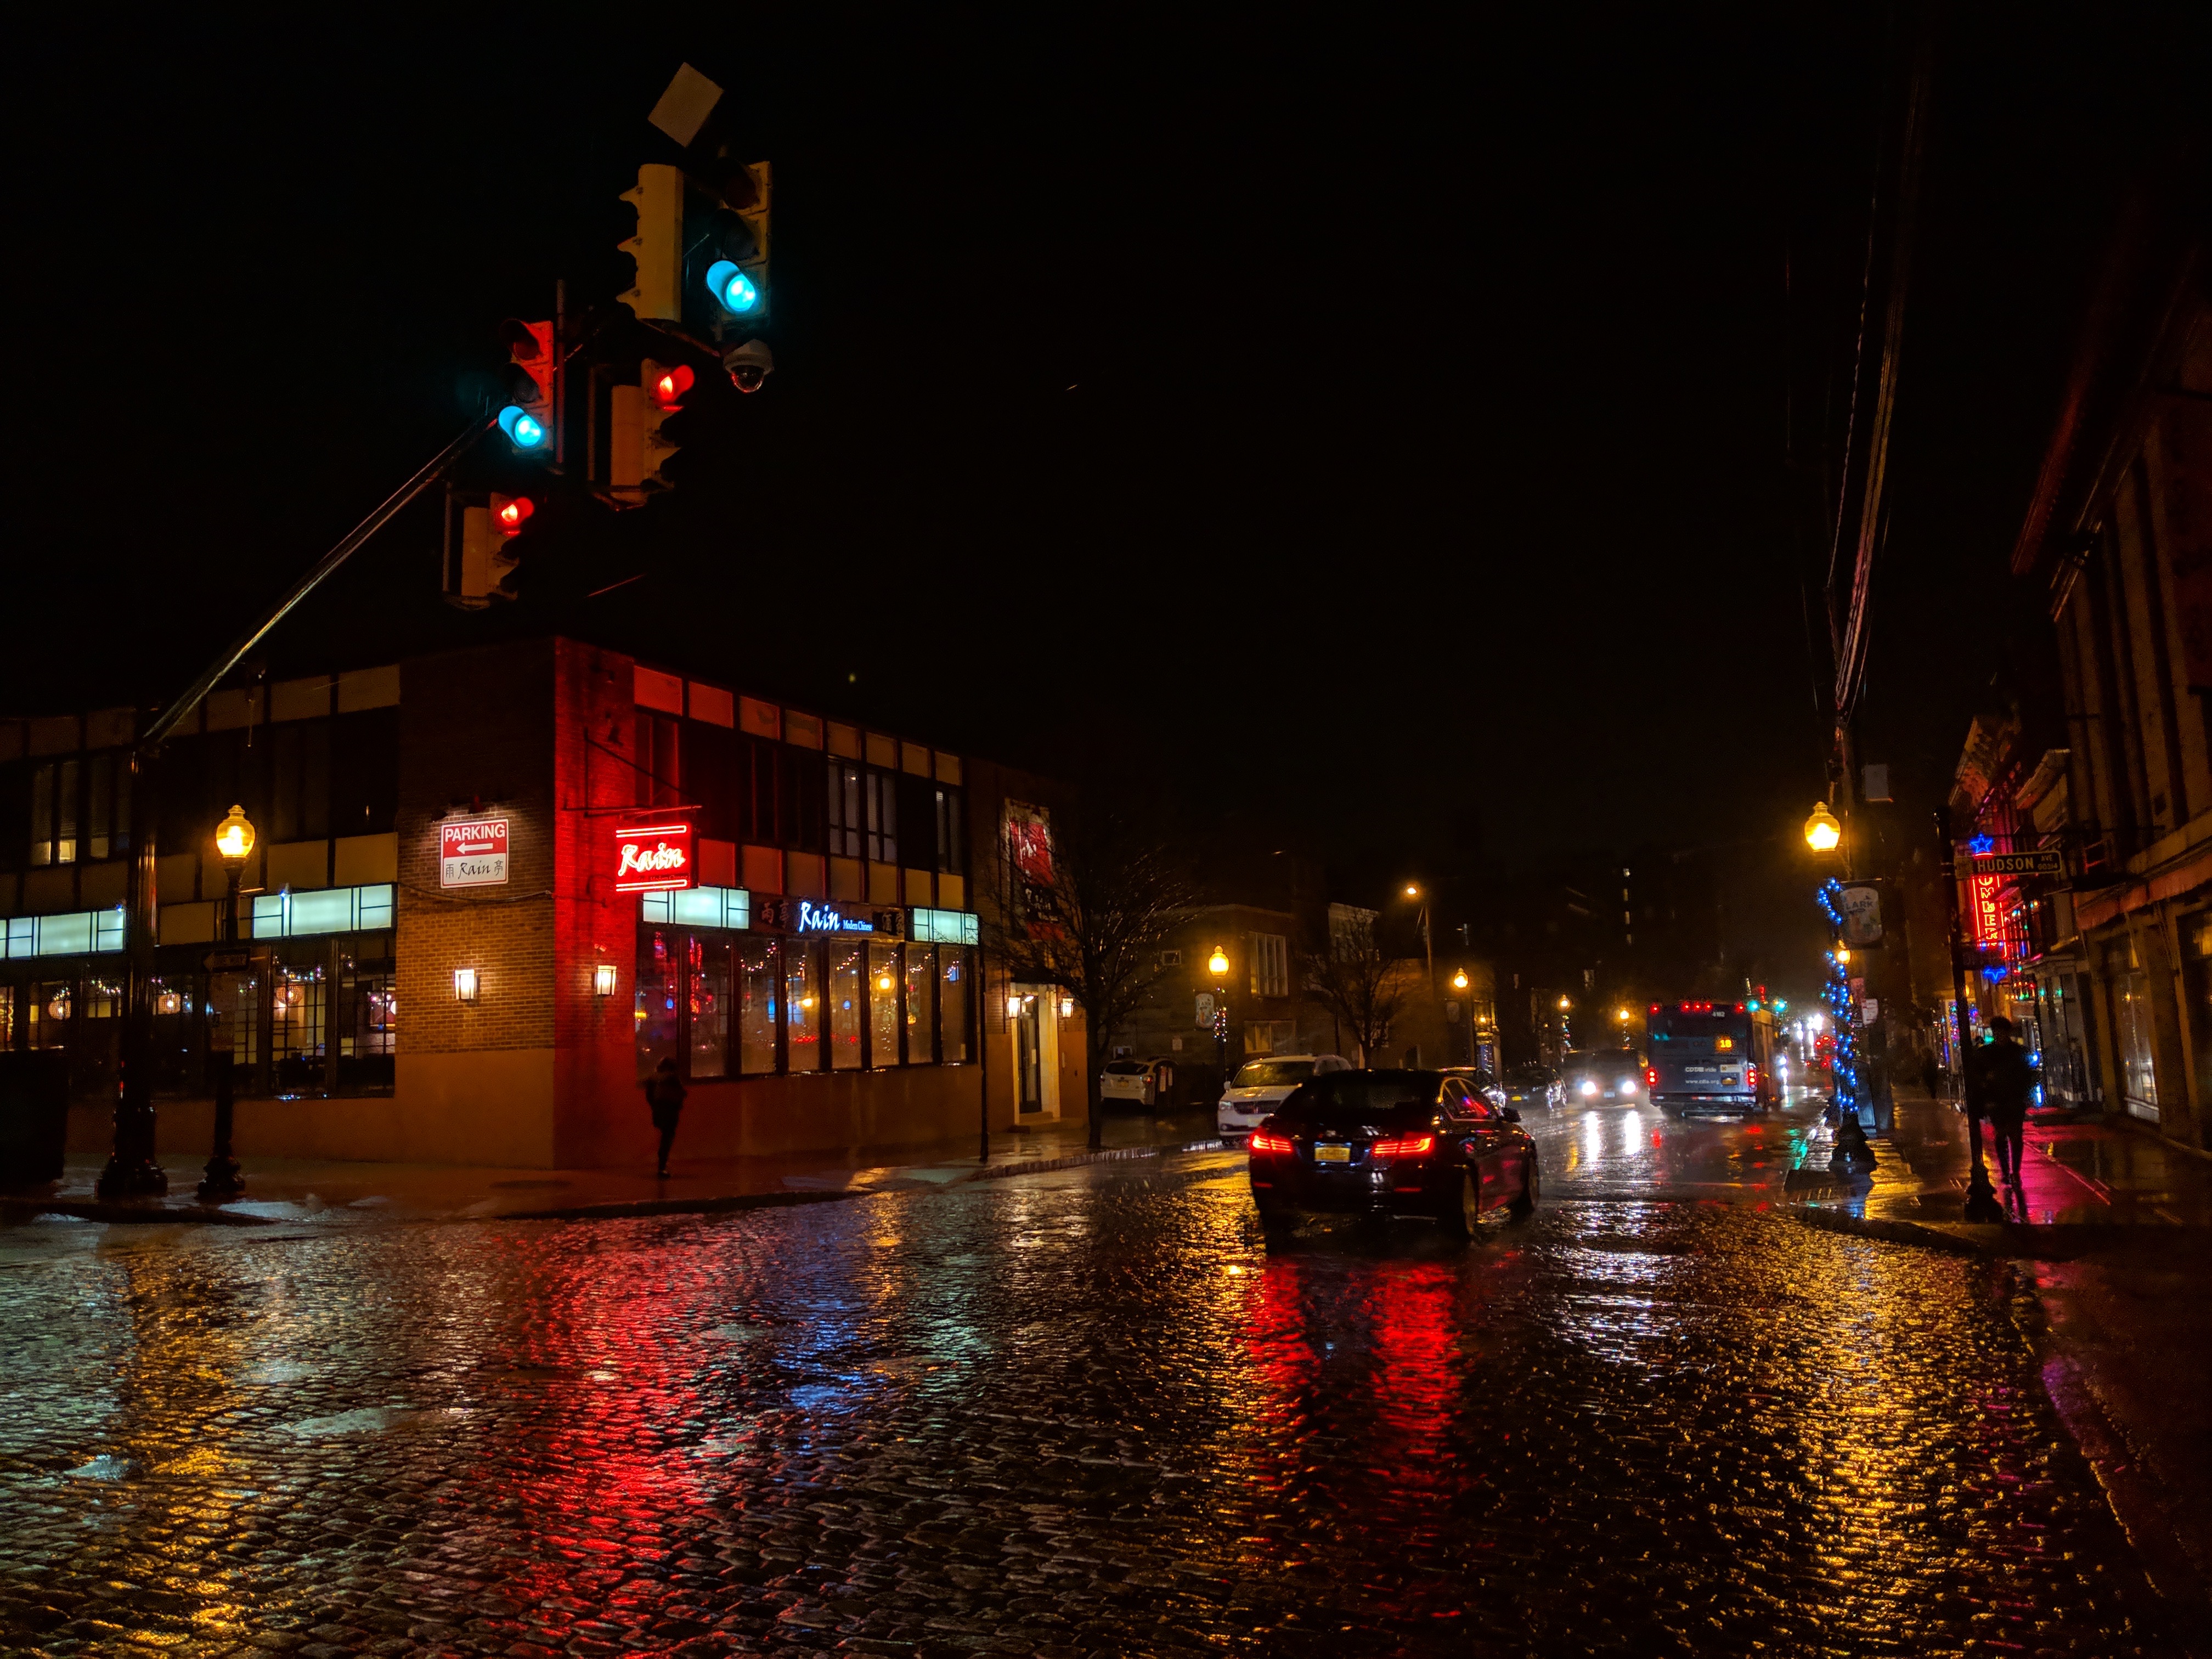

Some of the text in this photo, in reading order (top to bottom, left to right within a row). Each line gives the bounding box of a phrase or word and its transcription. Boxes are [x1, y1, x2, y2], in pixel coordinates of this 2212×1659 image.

[445, 823, 505, 842] PARKING
[618, 842, 686, 877] Rain
[1977, 857, 2034, 873] HUDSON
[445, 864, 454, 878] 雨
[458, 860, 490, 880] Rain
[1845, 900, 1873, 910] LARK
[799, 901, 840, 932] Rain
[1720, 1039, 1732, 1048] 18
